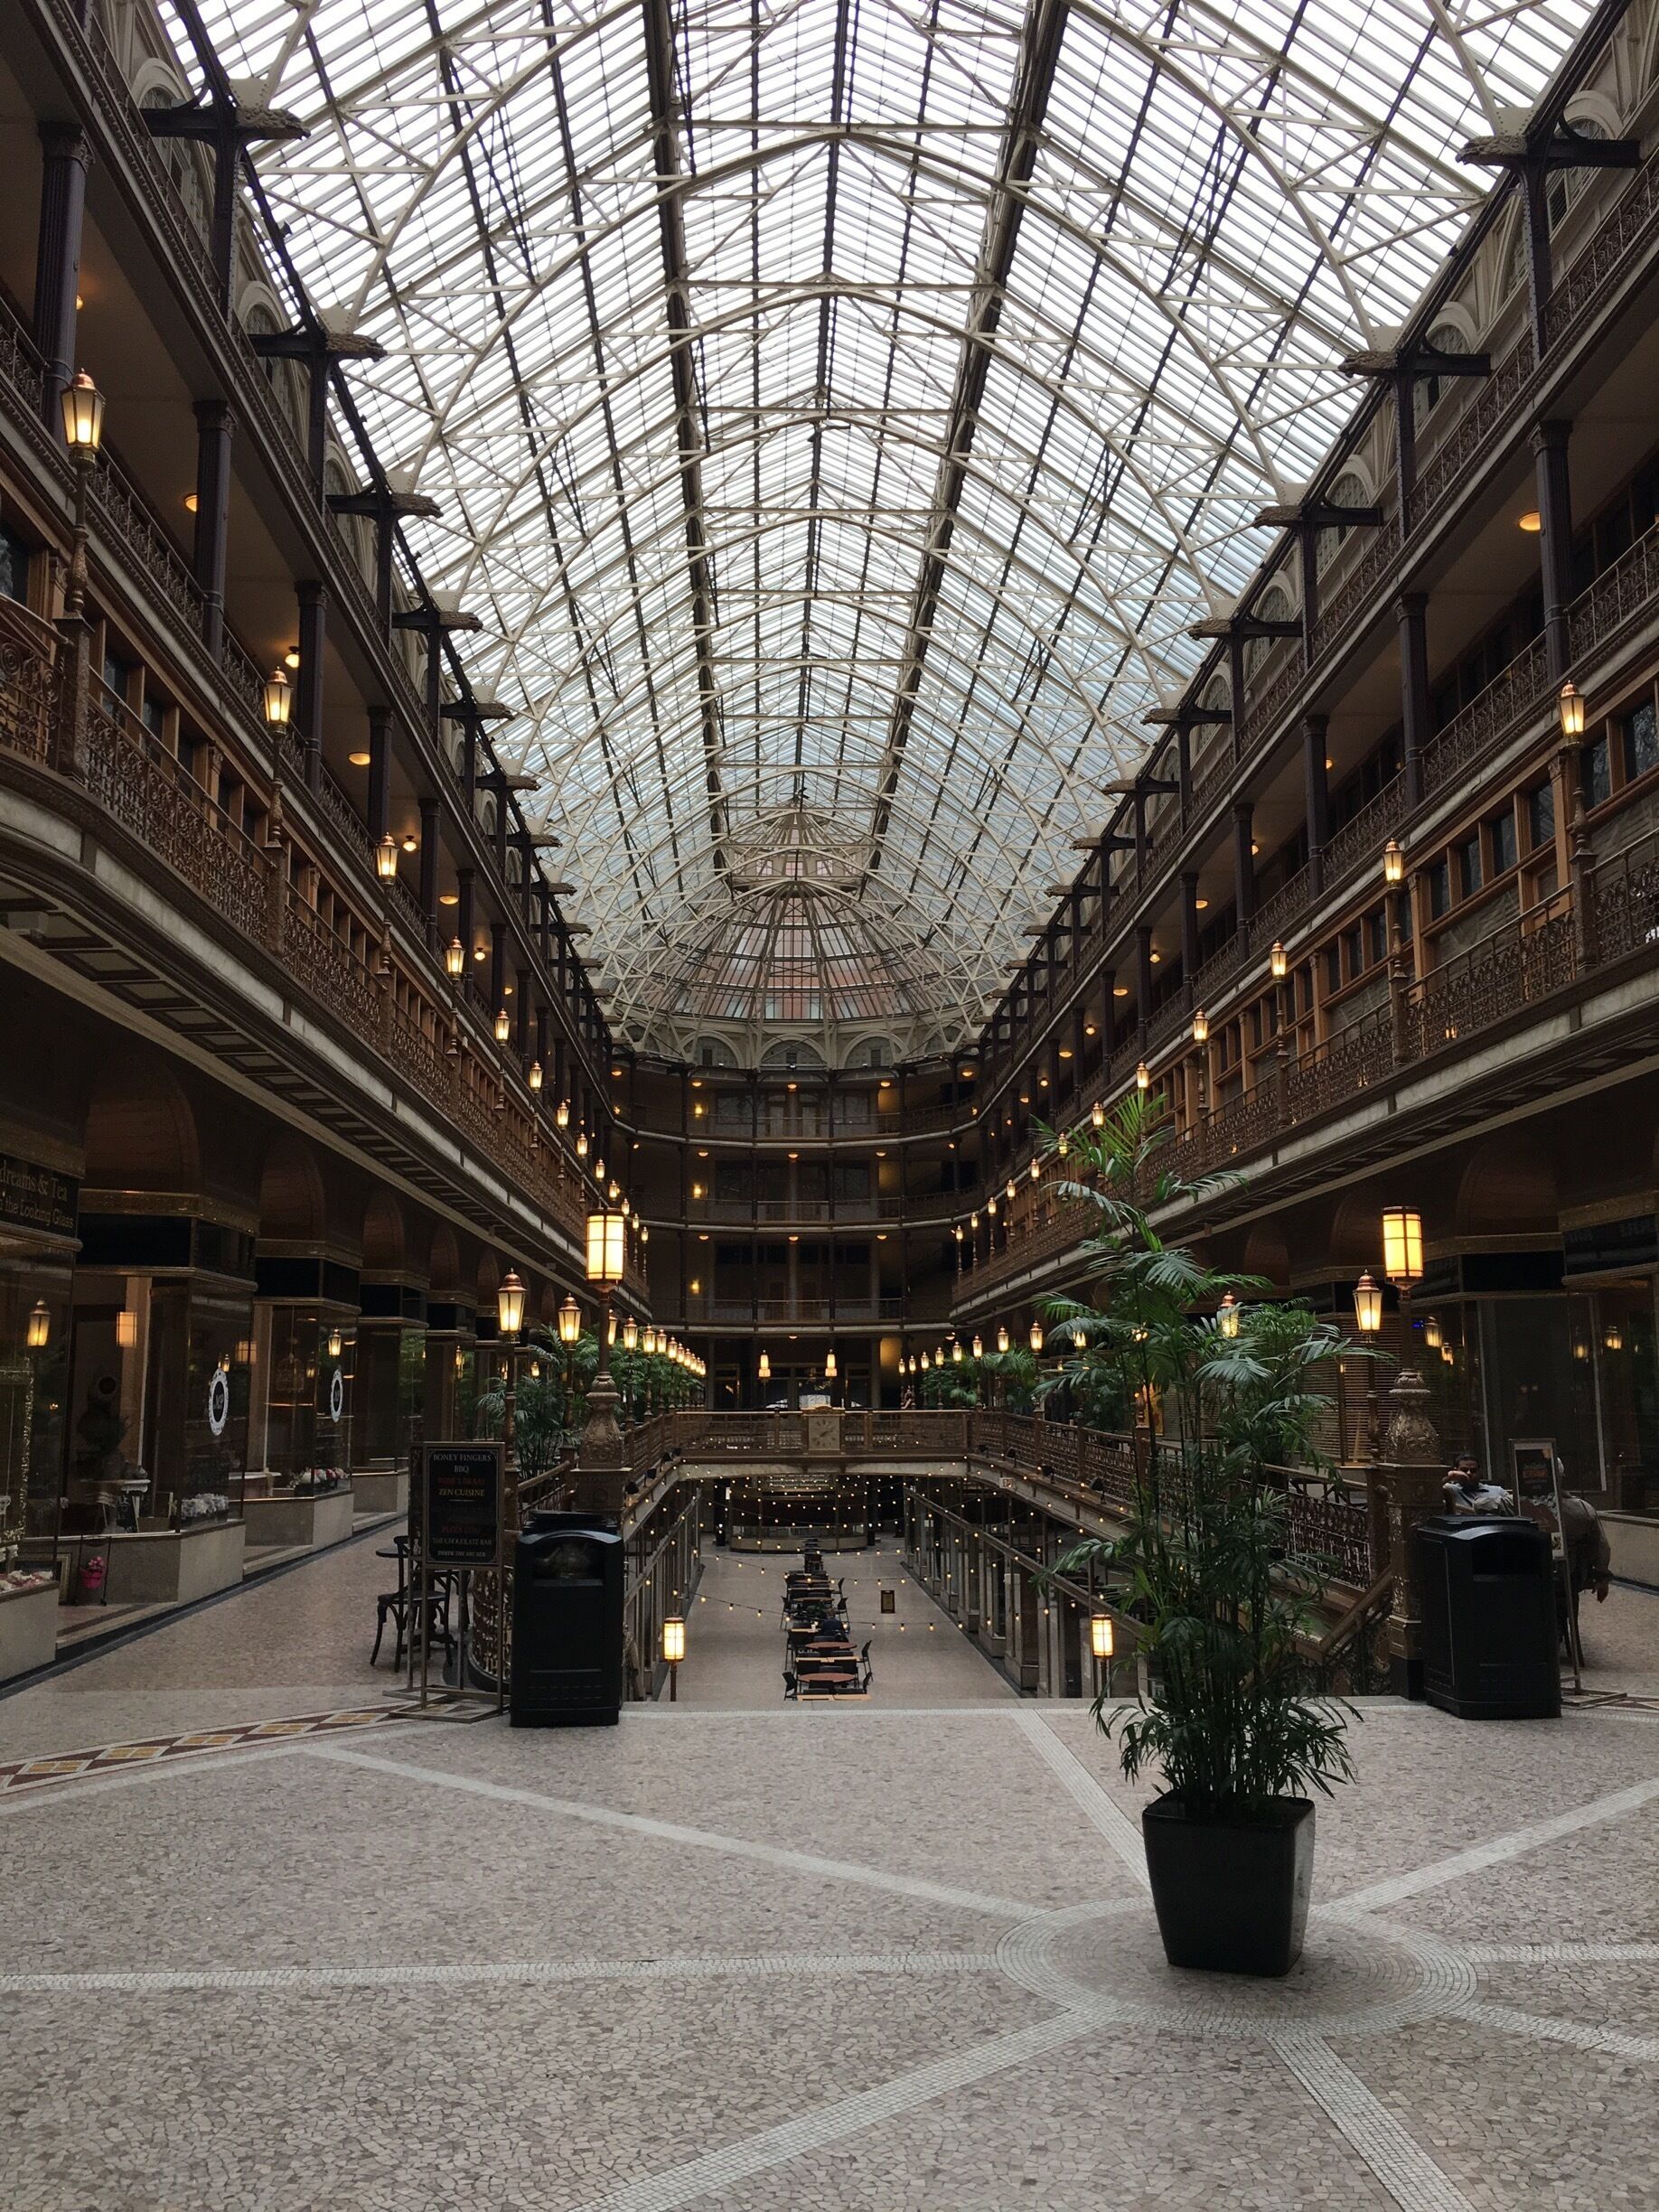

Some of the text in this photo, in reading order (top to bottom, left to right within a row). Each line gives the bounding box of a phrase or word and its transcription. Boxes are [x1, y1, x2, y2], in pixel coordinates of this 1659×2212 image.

[38, 1174, 48, 1196] &
[51, 1177, 68, 1202] Tea
[19, 1198, 51, 1227] Looking
[52, 1207, 74, 1229] Glass
[459, 1453, 492, 1462] FINGERS
[454, 1465, 470, 1474] BBQ
[454, 1488, 485, 1497] CUISINE
